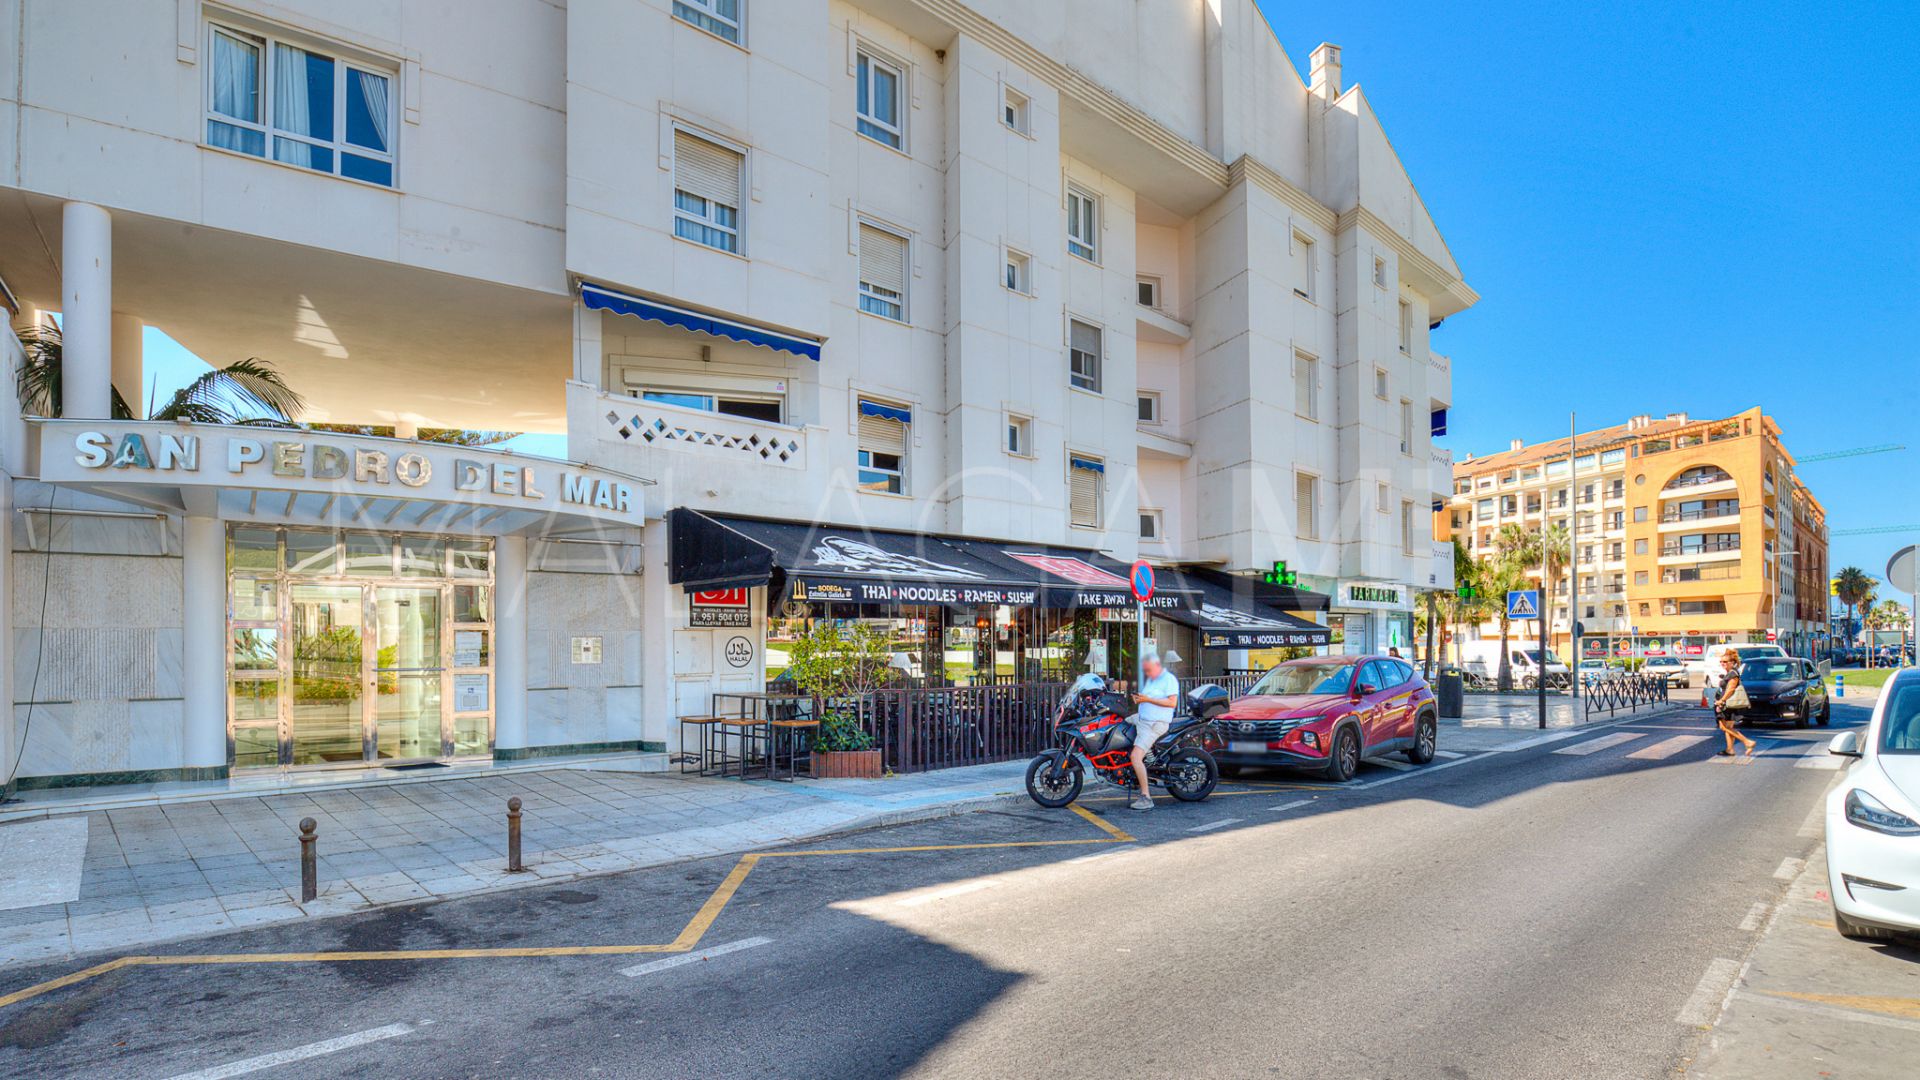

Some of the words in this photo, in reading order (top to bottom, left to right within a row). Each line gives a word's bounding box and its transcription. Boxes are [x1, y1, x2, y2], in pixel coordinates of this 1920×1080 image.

[75, 432, 199, 471] SAN
[227, 437, 433, 487] PEDRO
[455, 459, 546, 499] DEL
[561, 473, 634, 513] MAR
[861, 585, 892, 600] THAI
[899, 587, 956, 602] NOODLES
[964, 589, 1001, 603] RAMEN
[1008, 592, 1034, 604] SUSHI
[1078, 593, 1102, 605] TAKE
[1104, 594, 1126, 606] AWAY
[693, 613, 699, 621] T.
[702, 613, 715, 621] 951
[734, 613, 748, 621] 012
[1238, 634, 1252, 644] THAI
[1257, 635, 1284, 644] NOODLES
[1289, 634, 1307, 643] RAMEN
[728, 643, 750, 655] حلال
